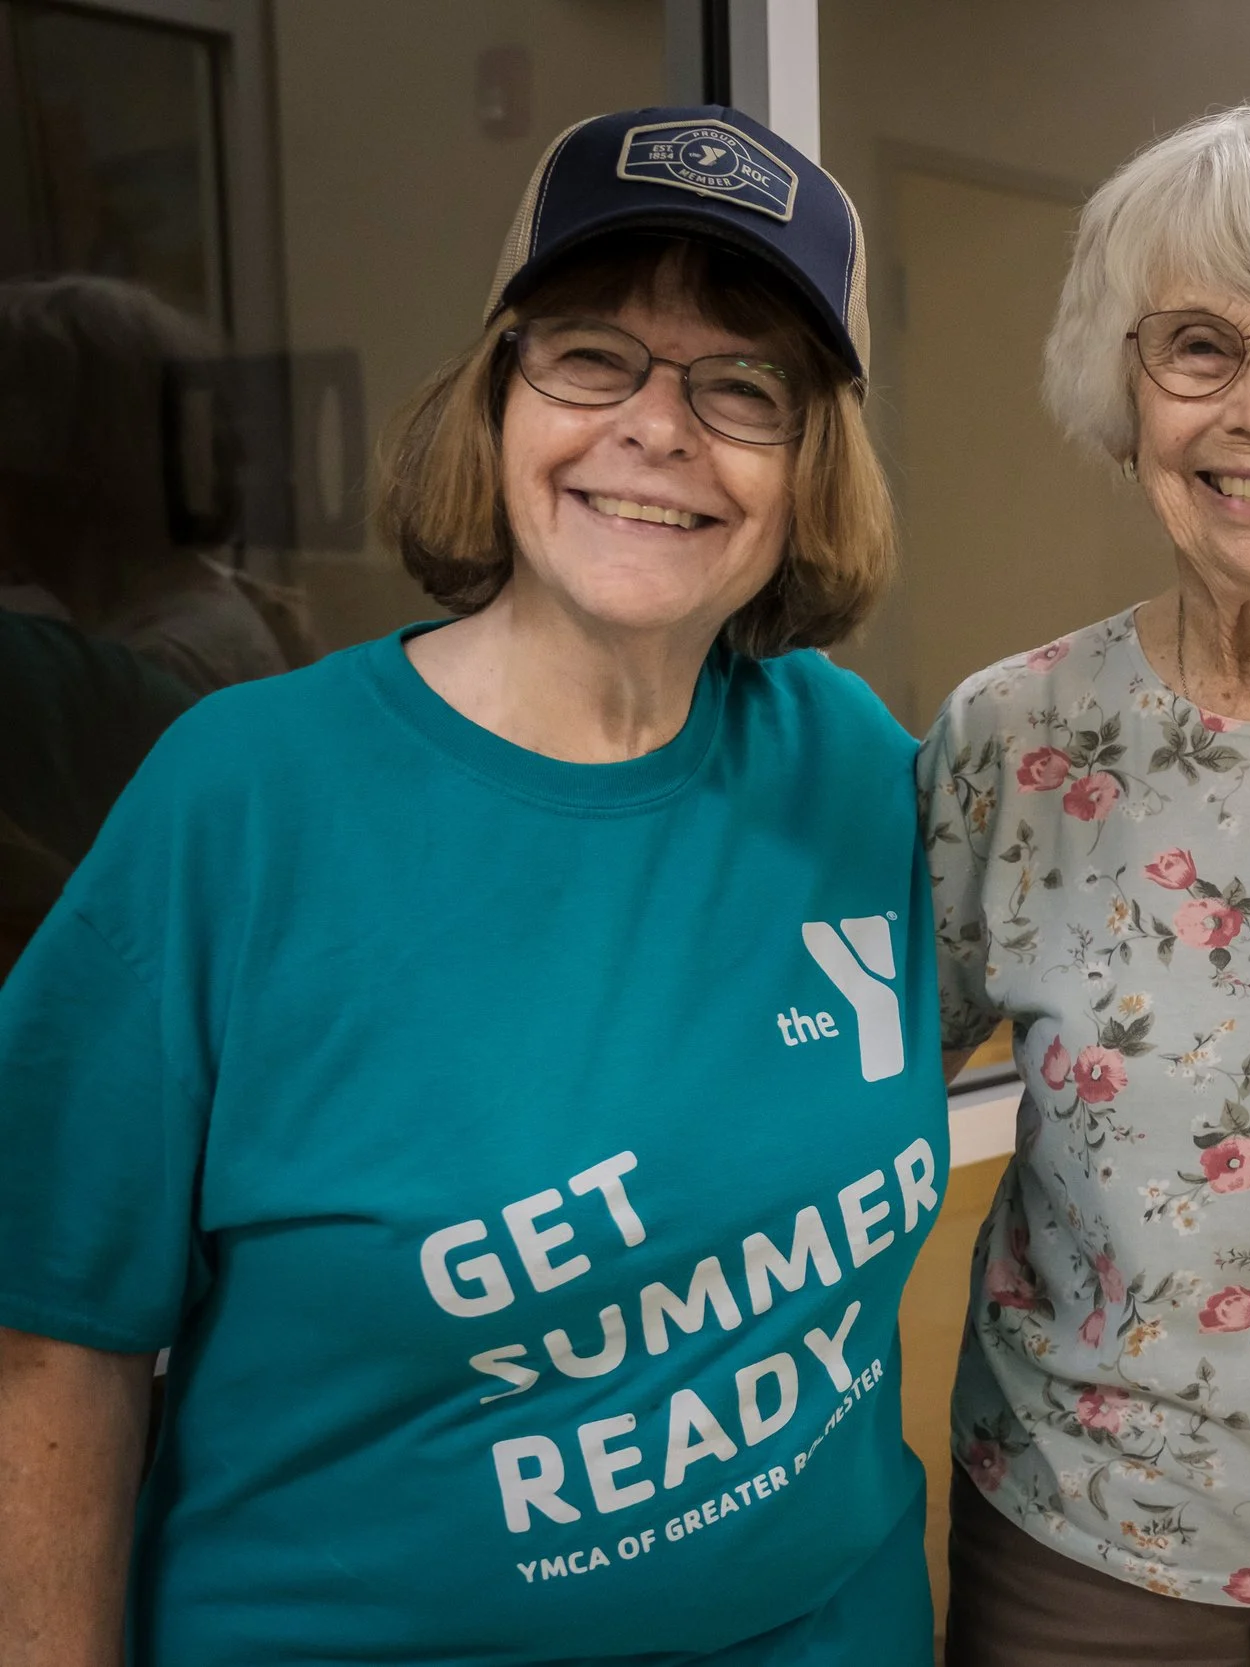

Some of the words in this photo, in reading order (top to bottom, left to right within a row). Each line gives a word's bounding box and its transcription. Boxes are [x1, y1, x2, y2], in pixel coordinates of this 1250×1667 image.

[648, 152, 674, 160] 1854
[678, 168, 733, 187] MEMBER
[692, 130, 737, 148] PROUD
[741, 163, 772, 189] ROC
[777, 1007, 839, 1047] the
[802, 915, 905, 1083] Y
[420, 1150, 647, 1318] GET
[468, 1137, 939, 1405] SUMMER
[492, 1300, 862, 1534] READY
[517, 1546, 610, 1583] YMCA
[617, 1529, 656, 1561] OF
[665, 1465, 789, 1542] GREATER
